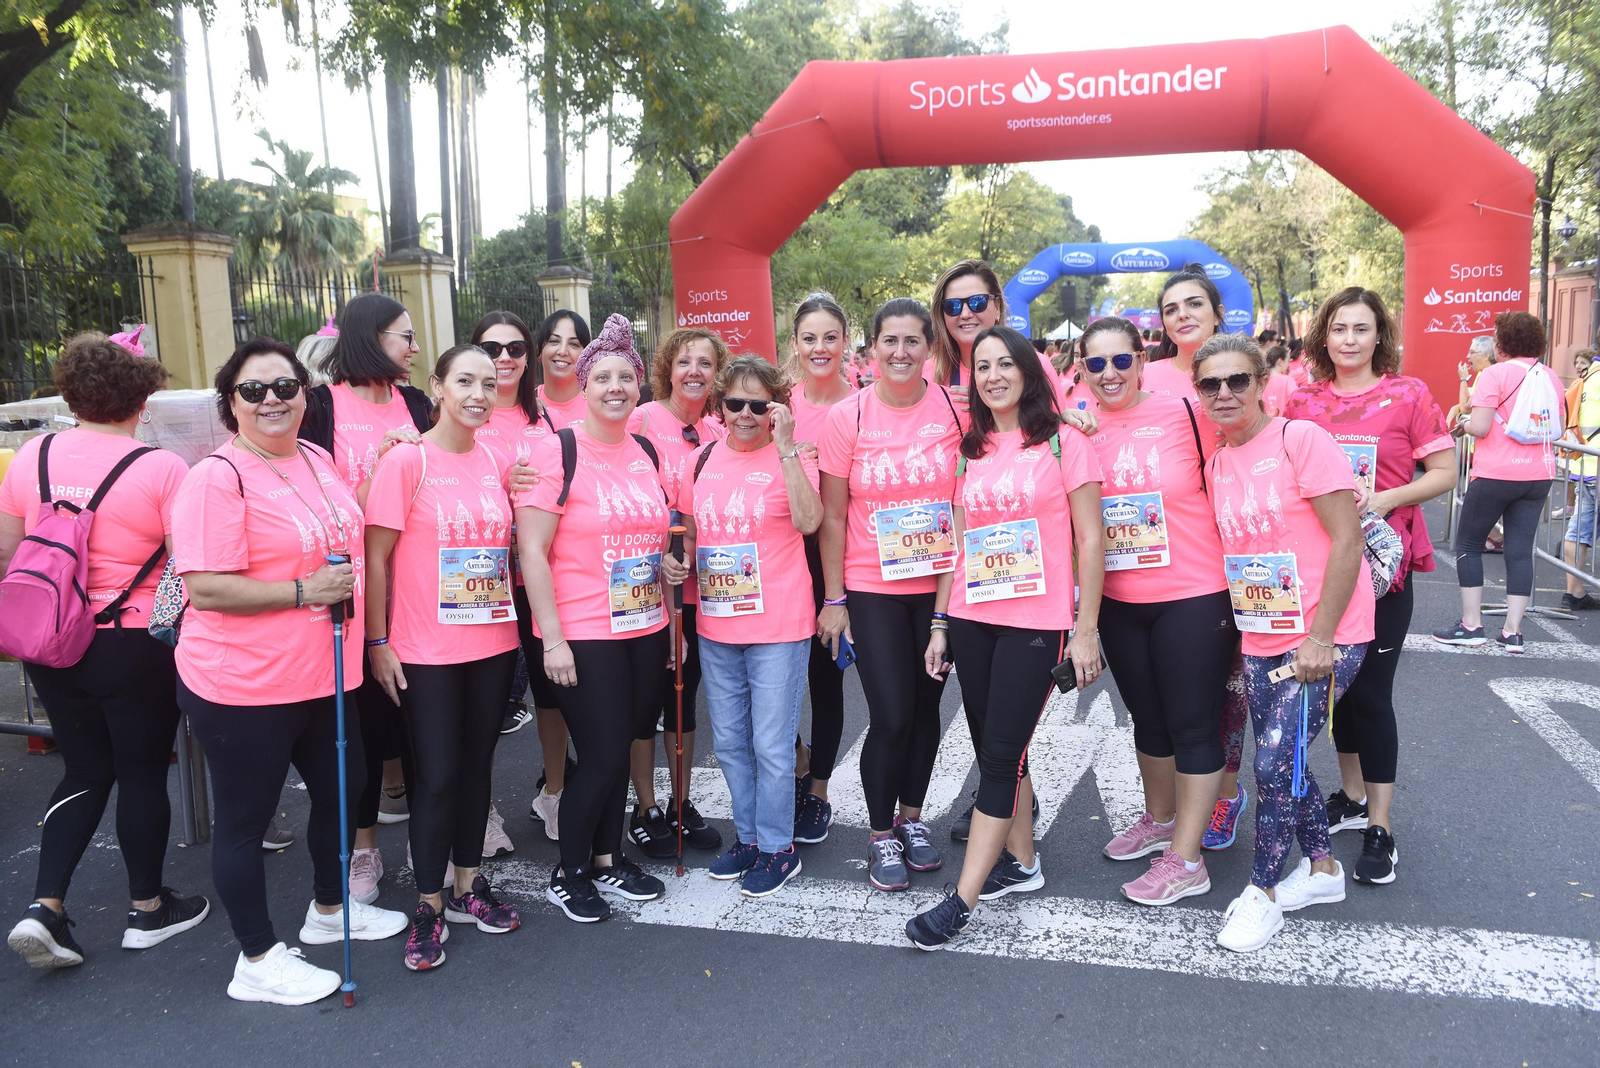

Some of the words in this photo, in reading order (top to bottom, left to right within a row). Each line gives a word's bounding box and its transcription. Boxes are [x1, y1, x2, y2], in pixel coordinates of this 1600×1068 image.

[909, 79, 1006, 117] Sports
[1056, 64, 1228, 101] Santander
[1006, 112, 1112, 132] sportssantander.es
[1115, 256, 1165, 268] ASTURIANA
[1450, 263, 1503, 282] Sports
[688, 289, 728, 306] Sports
[1444, 288, 1522, 304] Santander
[687, 309, 750, 325] Santander
[340, 424, 373, 432] OYSHO
[860, 429, 893, 439] OYSHO
[1335, 433, 1380, 444] Santander
[425, 477, 460, 486] OYSHO
[267, 485, 299, 500] OYSHO
[1105, 509, 1138, 518] ASTURIANA
[901, 518, 932, 527] ASTURIANA
[1106, 524, 1140, 540] 016
[601, 535, 621, 547] TU
[902, 531, 934, 548] 016
[985, 537, 1015, 547] ASTURIANA
[1116, 541, 1134, 549] 2819
[912, 548, 929, 556] 2820
[467, 562, 494, 570] ASTURIANA
[985, 551, 1016, 569] 016
[888, 567, 914, 576] OYSHO
[993, 569, 1010, 578] 2818
[466, 578, 494, 592] 016
[709, 574, 735, 587] 016
[632, 583, 654, 598] 016
[972, 589, 995, 598] OYSHO
[1245, 586, 1273, 600] 016
[617, 618, 640, 628] OYSHO
